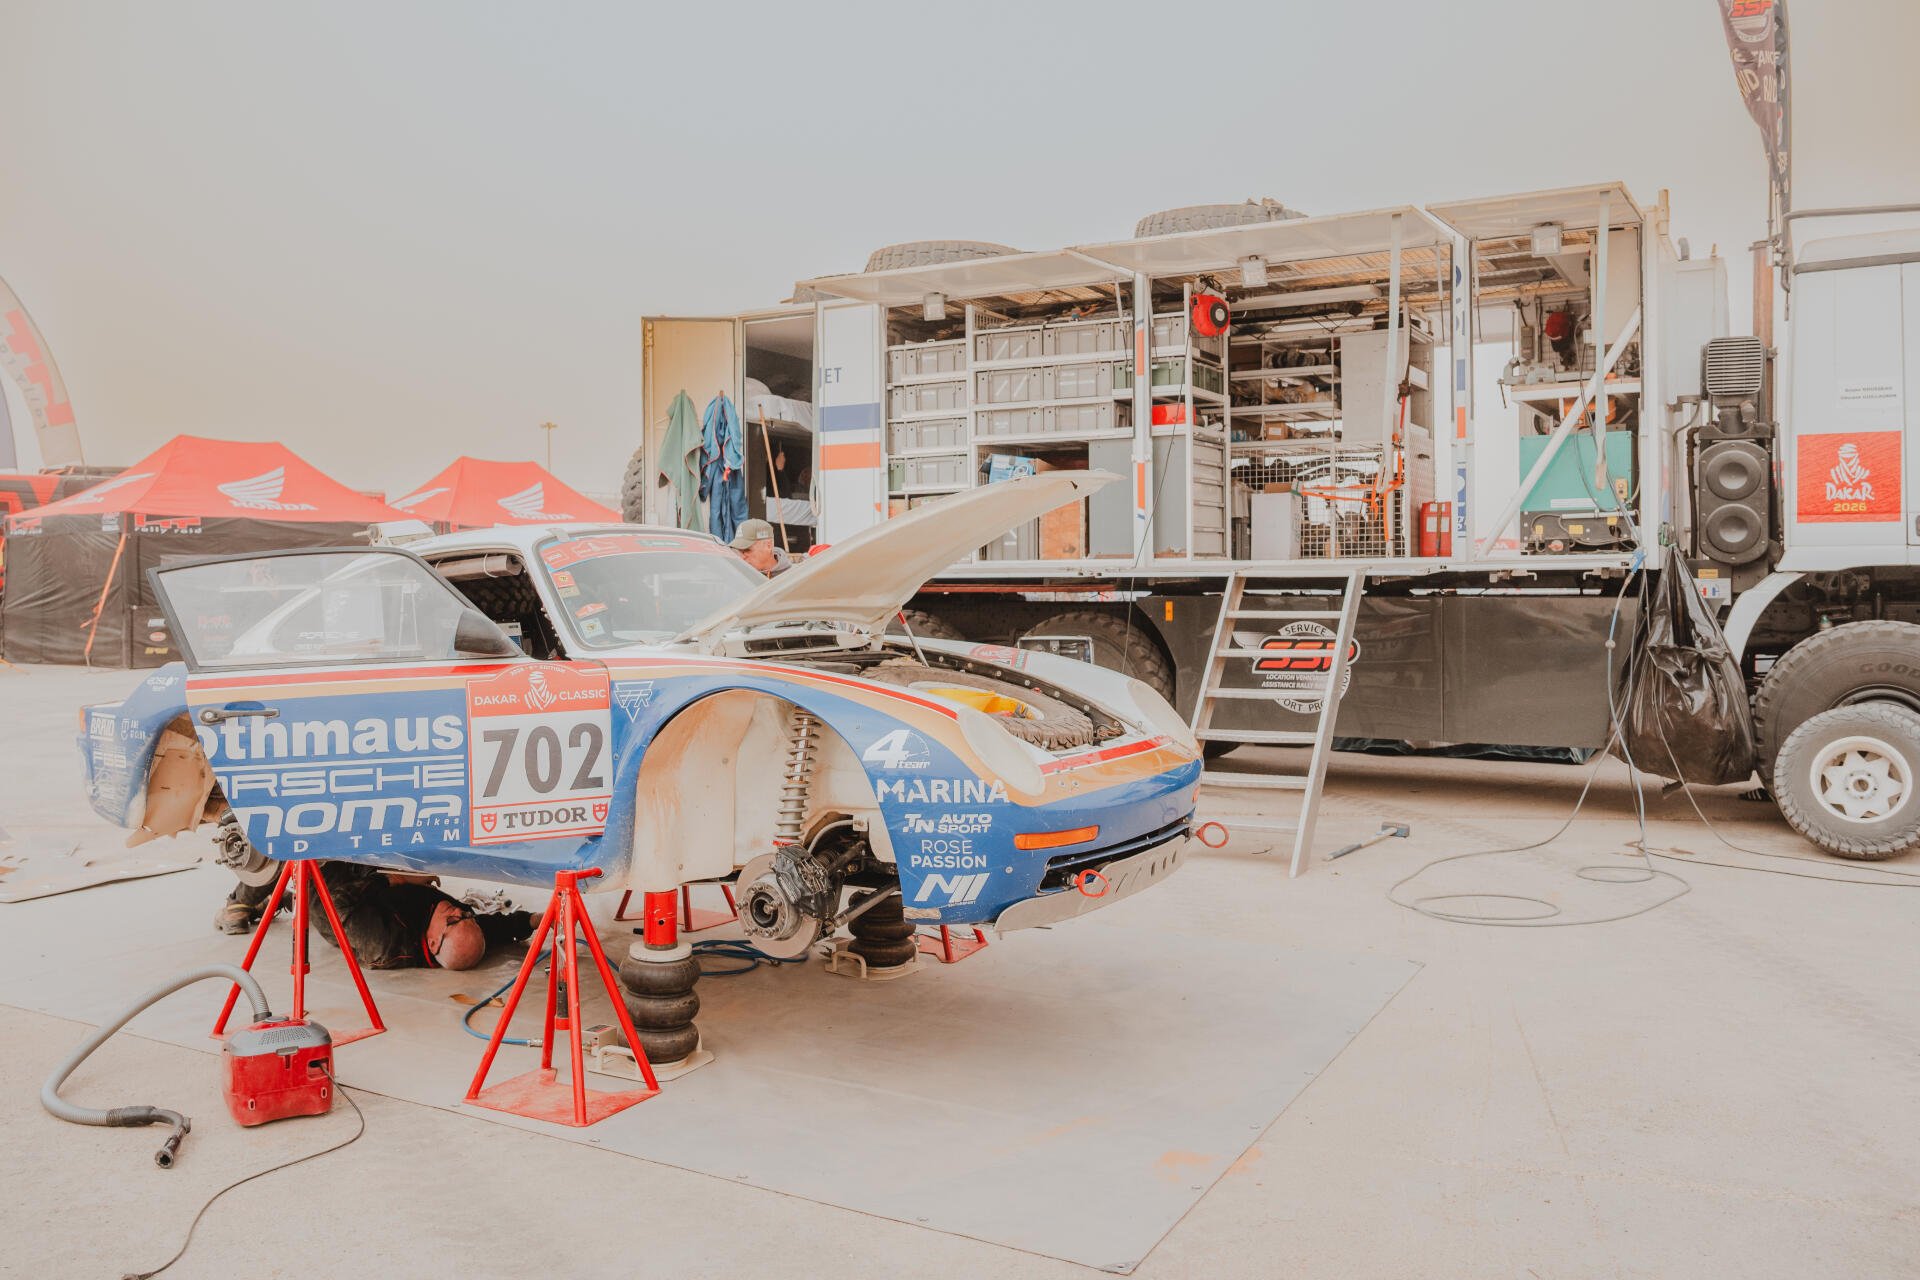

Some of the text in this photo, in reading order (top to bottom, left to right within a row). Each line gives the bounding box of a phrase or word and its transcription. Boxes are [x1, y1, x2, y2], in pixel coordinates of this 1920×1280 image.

[1825, 482, 1875, 501] DAKAR
[1833, 502, 1867, 512] 2026
[1284, 624, 1327, 636] SERVICE
[1266, 673, 1295, 681] LOCATION
[1261, 681, 1296, 689] ASSISTANCE
[474, 694, 518, 707] DAKAR
[559, 689, 607, 702] CLASSIC
[482, 722, 604, 798] 702
[876, 779, 1010, 804] MARINA
[416, 816, 460, 828] bikes
[503, 806, 588, 829] TUDOR
[939, 813, 993, 825] AUTO
[937, 823, 992, 834] SPORT
[350, 828, 461, 849] TEAM
[921, 839, 973, 855] ROSE
[911, 854, 987, 869] PASSION
